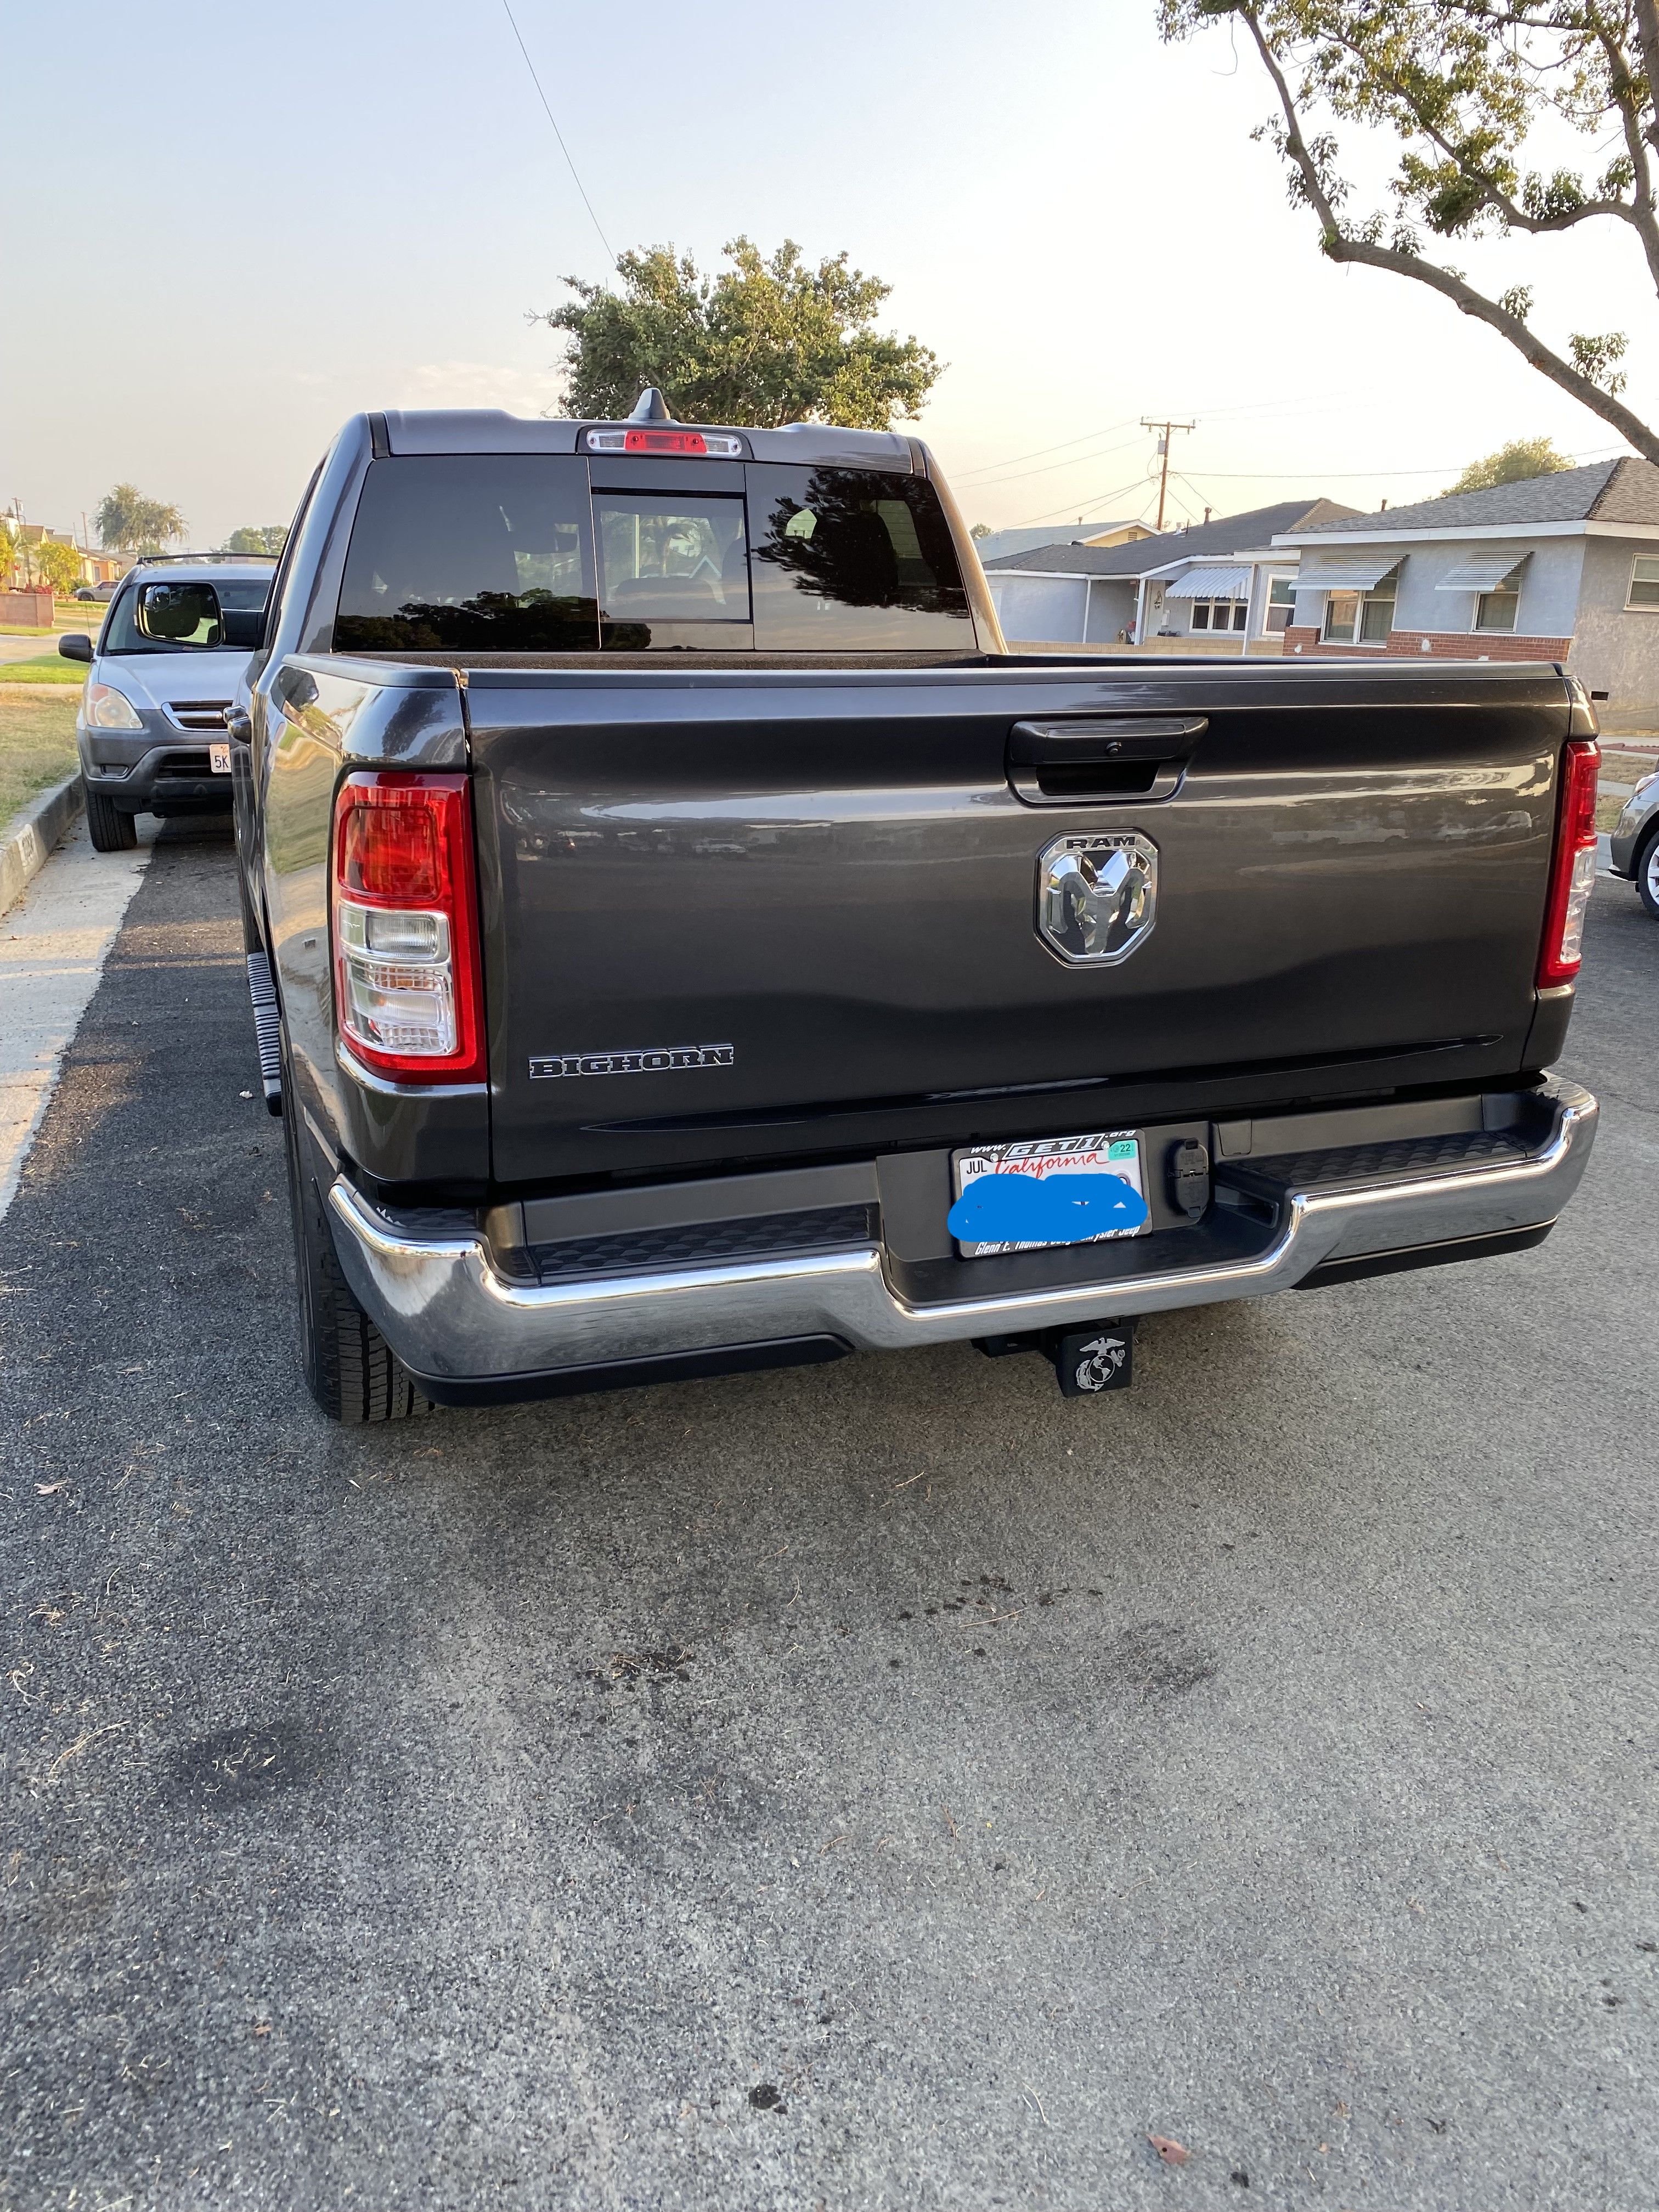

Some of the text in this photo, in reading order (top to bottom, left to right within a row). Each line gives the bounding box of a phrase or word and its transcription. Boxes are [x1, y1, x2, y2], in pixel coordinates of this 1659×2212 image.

[1066, 837, 1135, 849] RAM
[529, 1045, 734, 1079] BIGHORN
[1120, 1144, 1131, 1152] 22
[967, 1160, 988, 1174] JUL
[995, 1151, 1110, 1180] California
[975, 1242, 1001, 1255] Glenn
